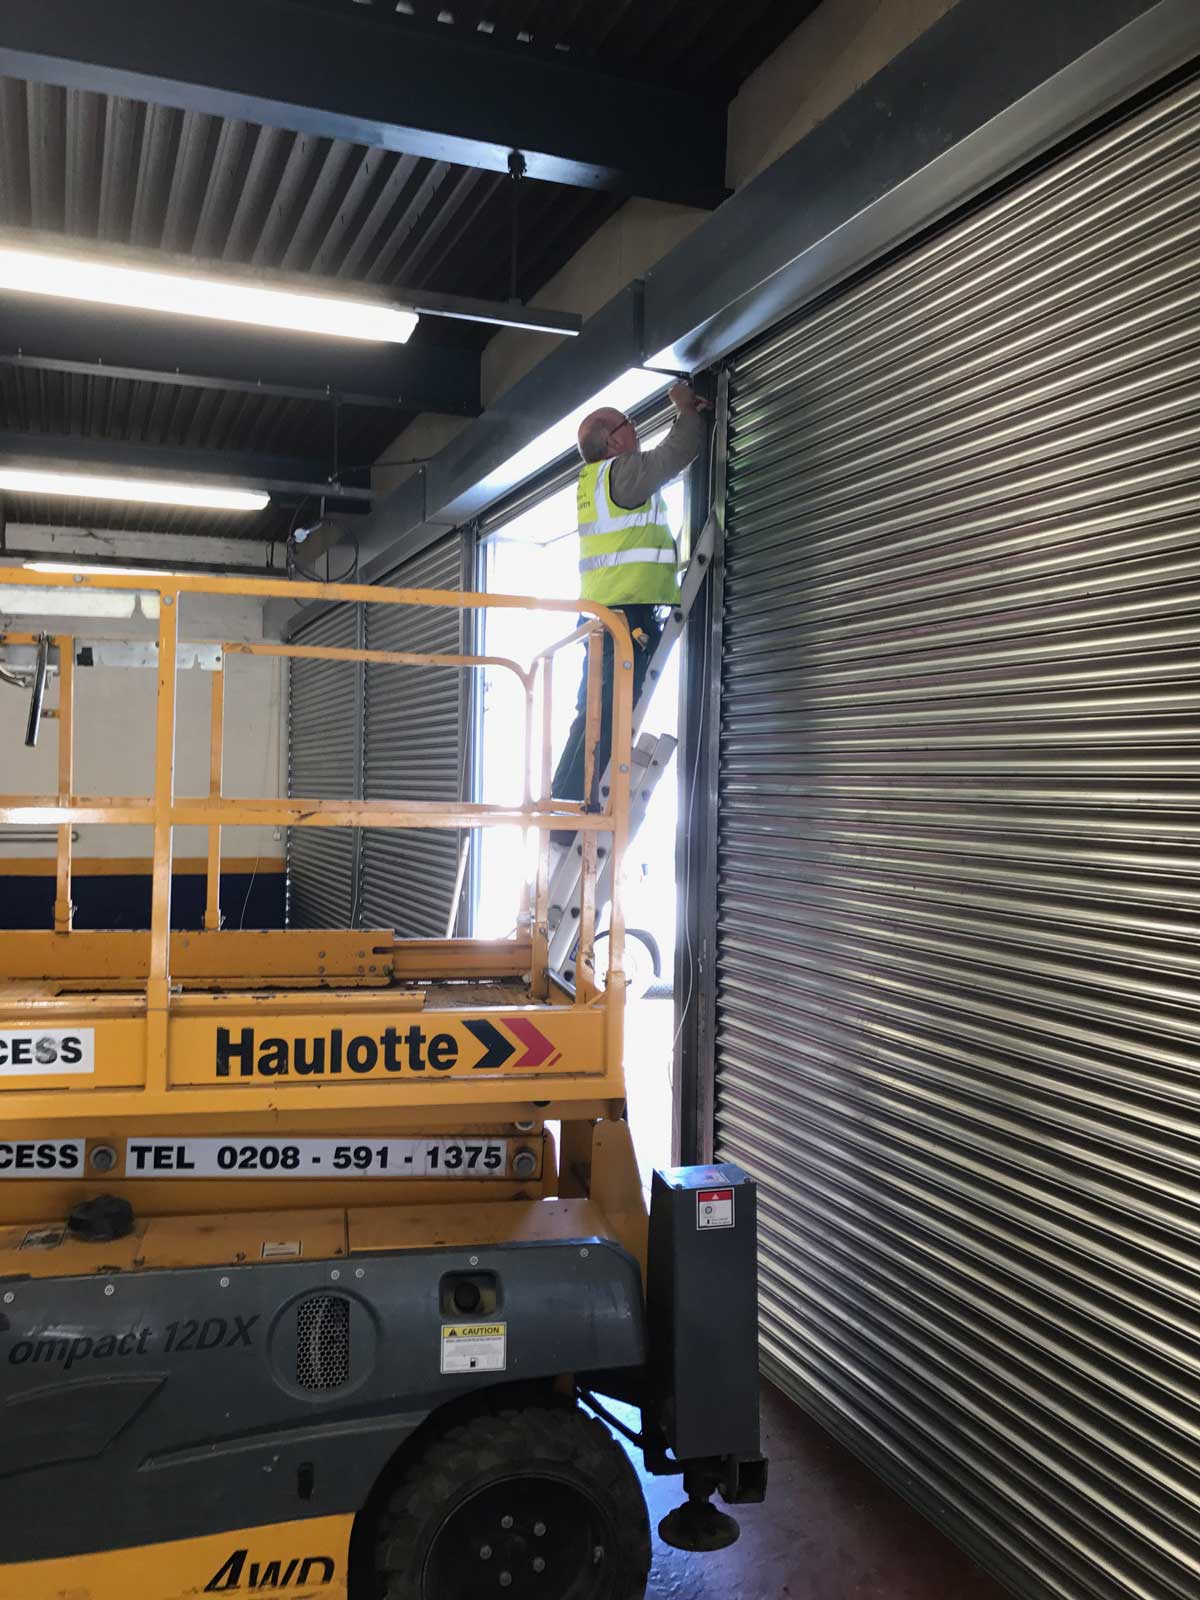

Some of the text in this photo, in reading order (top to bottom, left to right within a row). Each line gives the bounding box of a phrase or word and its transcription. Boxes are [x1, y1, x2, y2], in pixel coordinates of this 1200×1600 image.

[216, 1025, 459, 1077] Haulotte
[130, 1145, 195, 1170] TEL
[216, 1146, 300, 1170] 0208
[332, 1146, 389, 1169] 591
[426, 1146, 503, 1170] 1375
[0, 1313, 261, 1370] ompact 12DX
[462, 1326, 500, 1336] CAUTION
